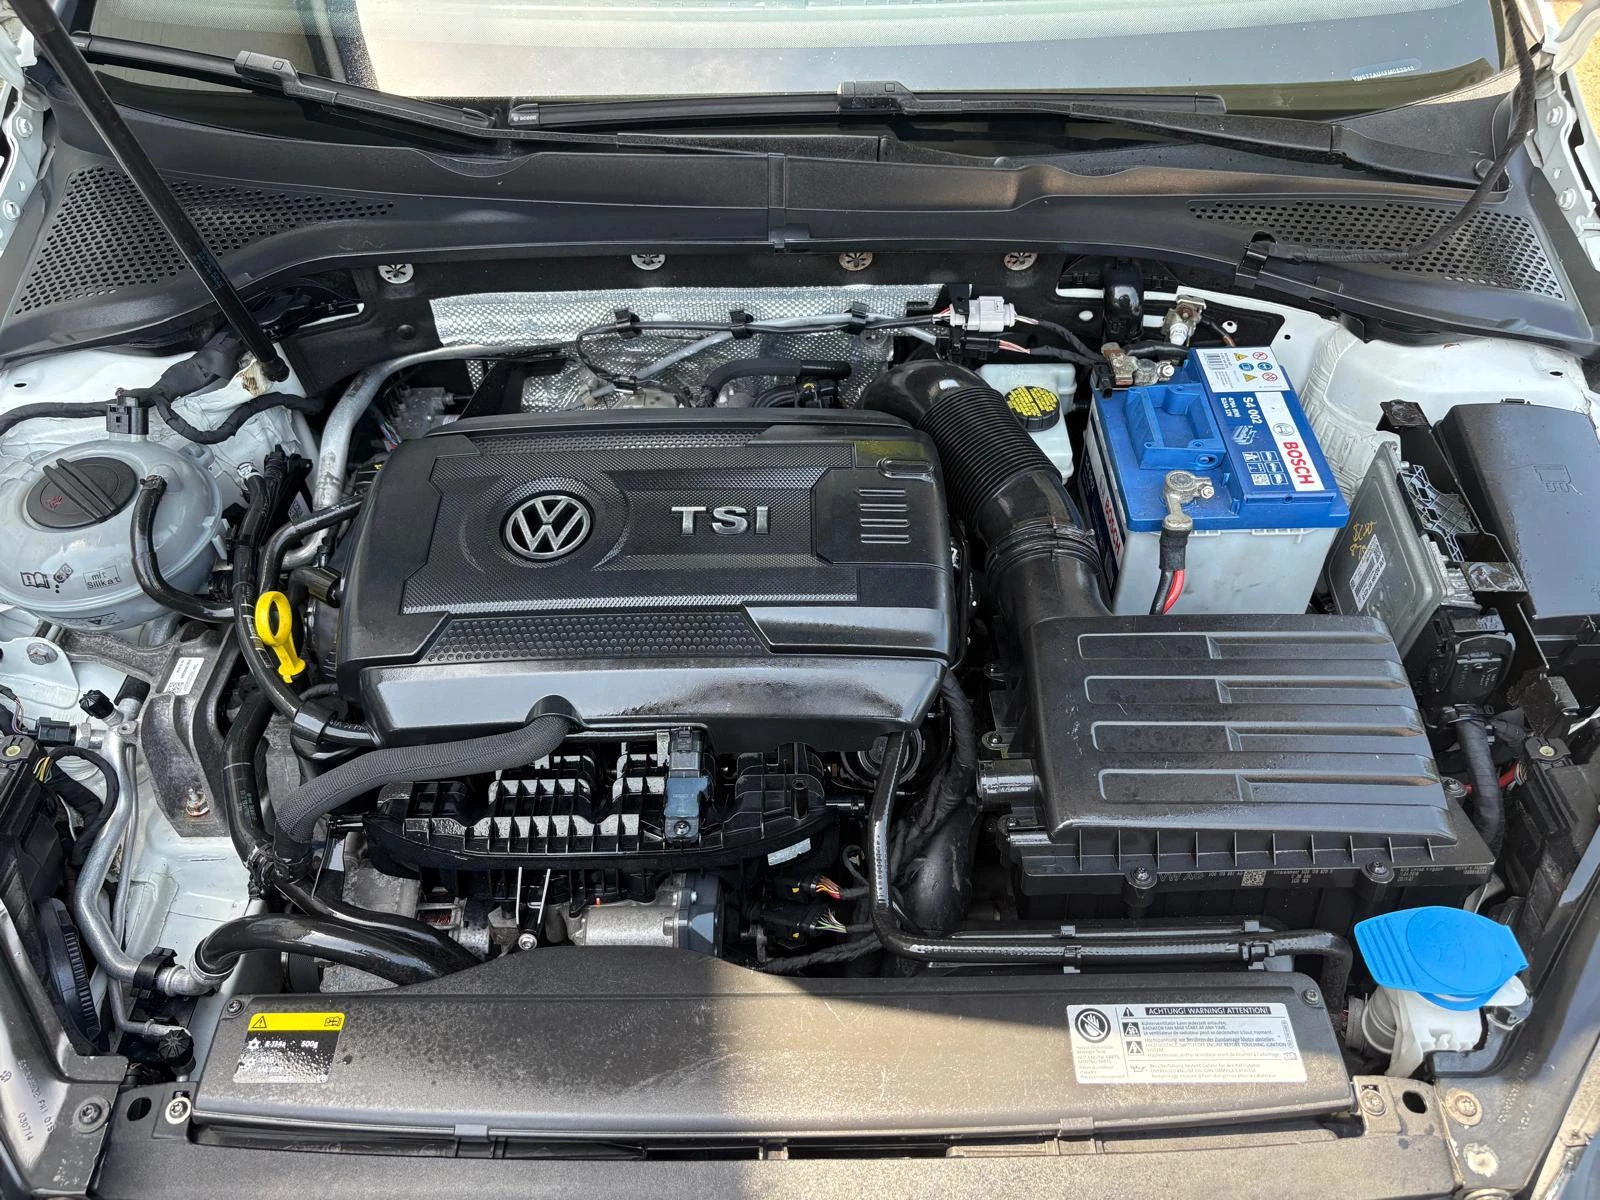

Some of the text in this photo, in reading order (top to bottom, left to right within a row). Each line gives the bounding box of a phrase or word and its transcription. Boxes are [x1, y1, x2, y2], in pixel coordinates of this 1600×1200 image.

[1243, 397, 1263, 424] S4 002
[1283, 441, 1315, 484] BOSCH
[671, 506, 770, 535] TSI
[1105, 497, 1121, 556] BOSCH
[92, 571, 106, 580] mit
[1149, 1007, 1186, 1015] ACHTUNG!
[1226, 1006, 1269, 1014] ATTENTION!
[301, 1040, 319, 1049] 500g
